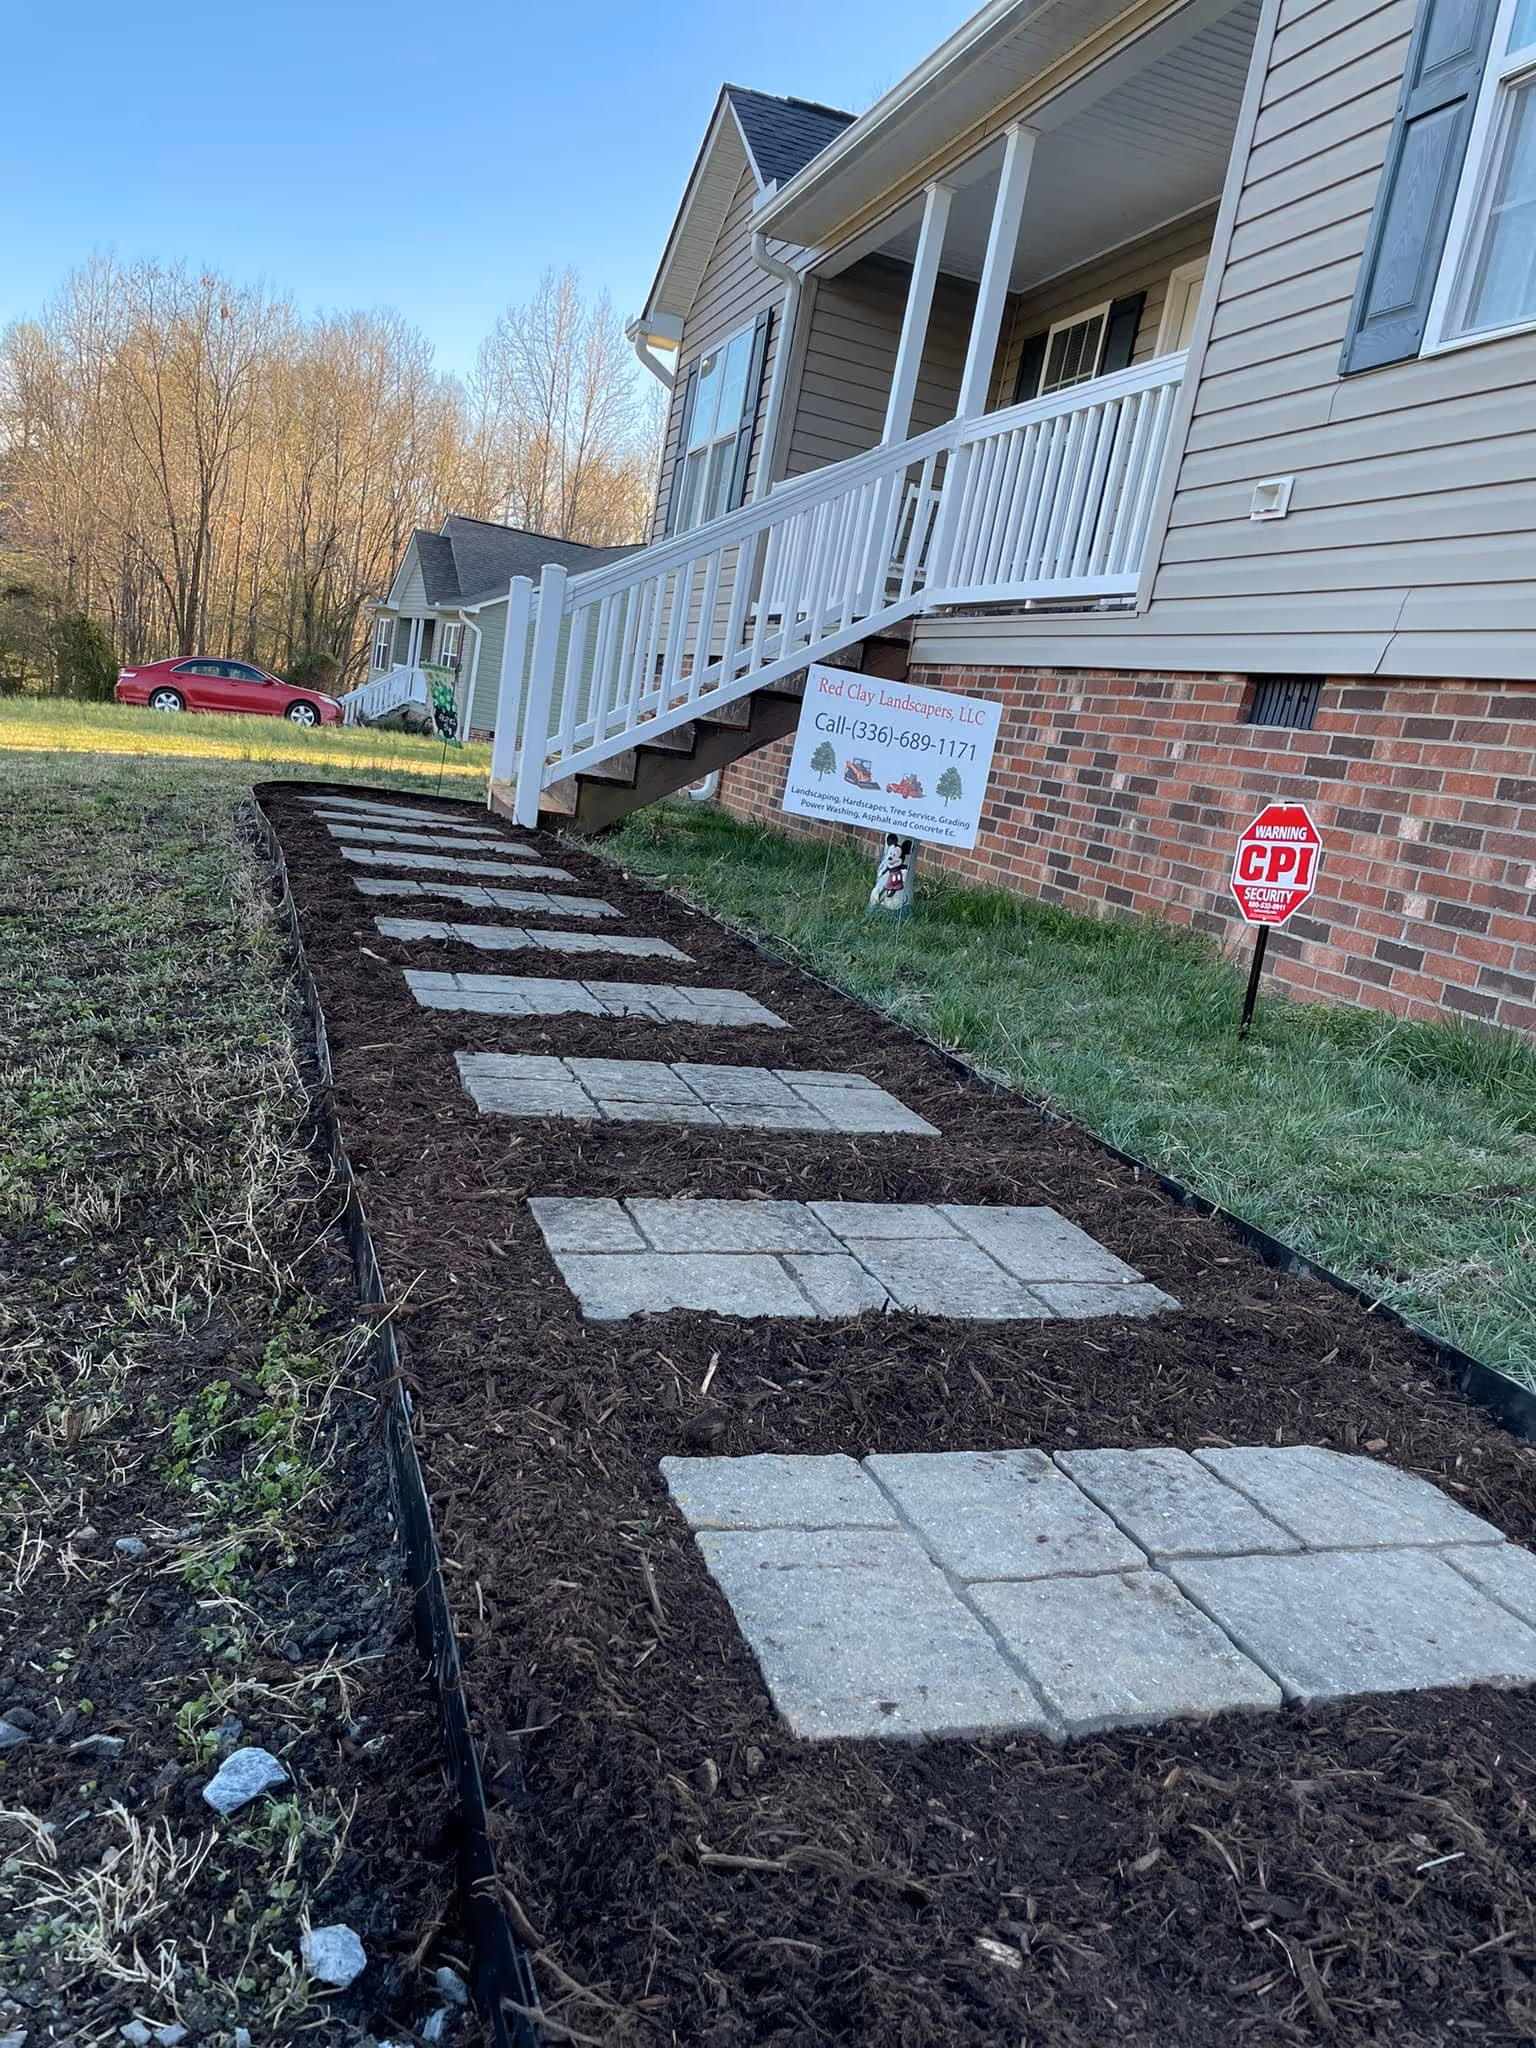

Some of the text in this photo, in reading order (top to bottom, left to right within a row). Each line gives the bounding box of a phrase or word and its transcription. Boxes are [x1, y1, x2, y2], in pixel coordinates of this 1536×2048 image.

[818, 677, 986, 726] Red Clay Landscapers, LLC
[815, 712, 976, 761] Call-(336)-689-1171
[791, 786, 970, 830] Landscaping, Hardscapes, Tree Service, Grading
[800, 799, 825, 811] Power
[826, 804, 861, 819] Washing,
[862, 812, 892, 825] Asphalt
[892, 818, 908, 828] and
[909, 821, 944, 835] Concrete
[1255, 825, 1307, 840] WARNING
[1239, 844, 1314, 885] CPI
[1243, 887, 1294, 904] SECURITY
